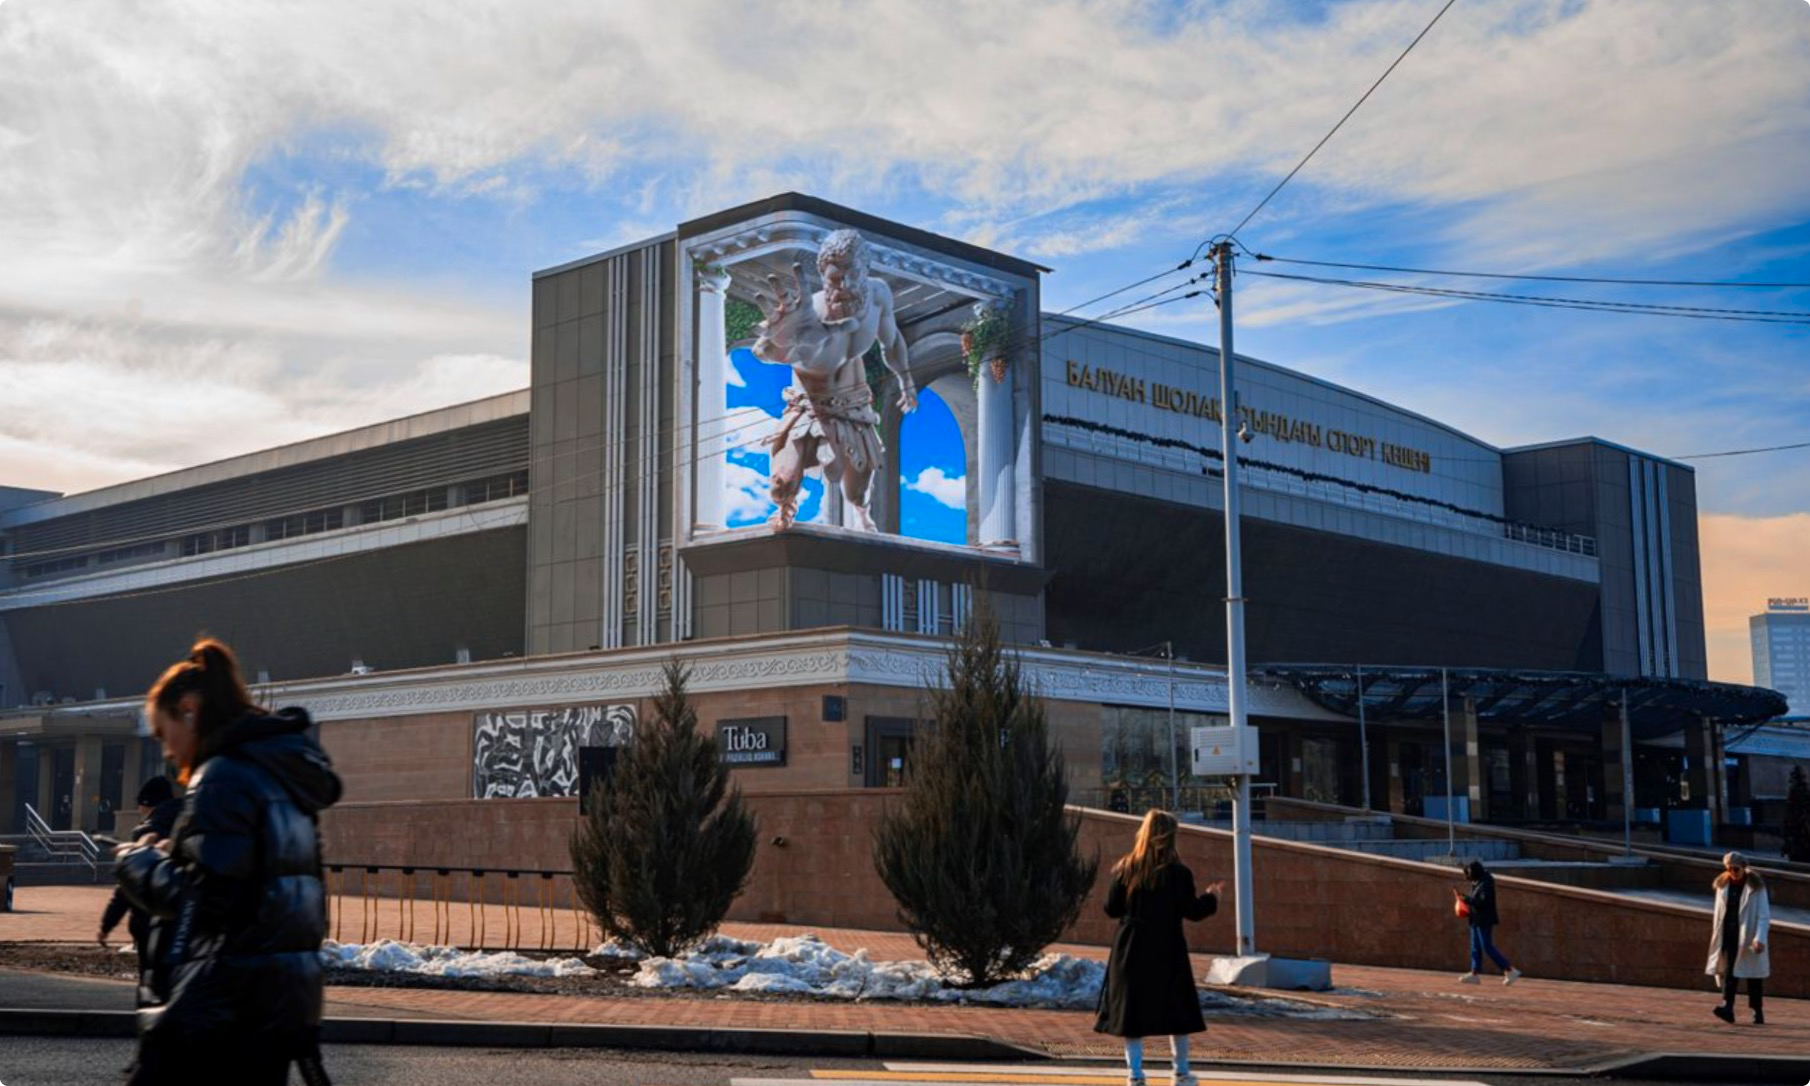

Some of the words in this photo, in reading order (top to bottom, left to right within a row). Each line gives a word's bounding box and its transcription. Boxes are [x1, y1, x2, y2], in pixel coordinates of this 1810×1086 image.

[1066, 360, 1145, 404] БАЛУАН
[1327, 430, 1375, 461] СПОРТ
[722, 726, 767, 751] Tuba
